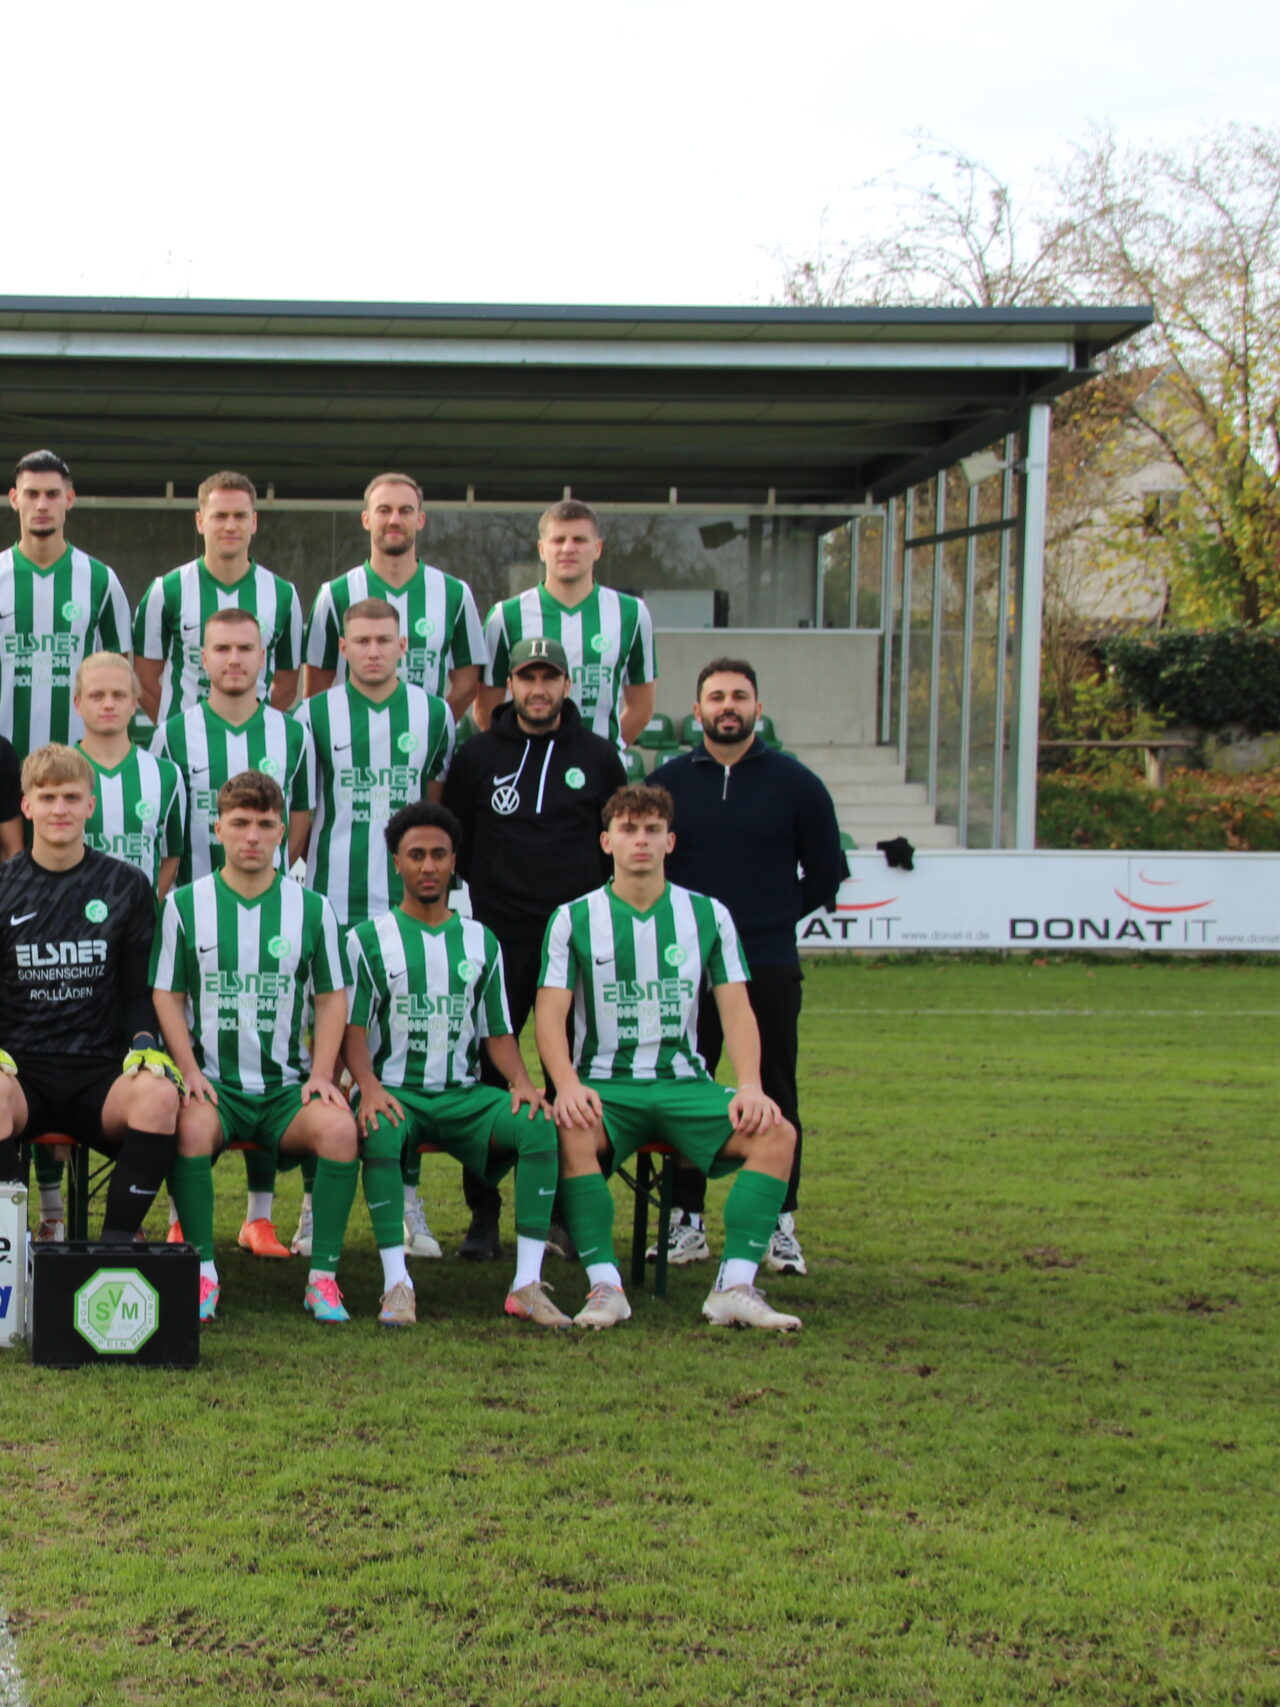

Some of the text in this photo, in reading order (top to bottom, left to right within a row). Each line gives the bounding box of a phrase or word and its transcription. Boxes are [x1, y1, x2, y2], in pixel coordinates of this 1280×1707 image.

[4, 633, 81, 655] ELSNER
[340, 766, 419, 788] ELSNER
[869, 917, 902, 940] IT
[901, 930, 990, 941] www.donat-it.de
[1009, 918, 1172, 942] DONAT
[1184, 920, 1217, 942] IT
[15, 939, 108, 968] ELSNER
[18, 964, 105, 982] SONNENSCHUTZ
[204, 971, 291, 997] ELSNER
[602, 979, 694, 1003] ELSNER
